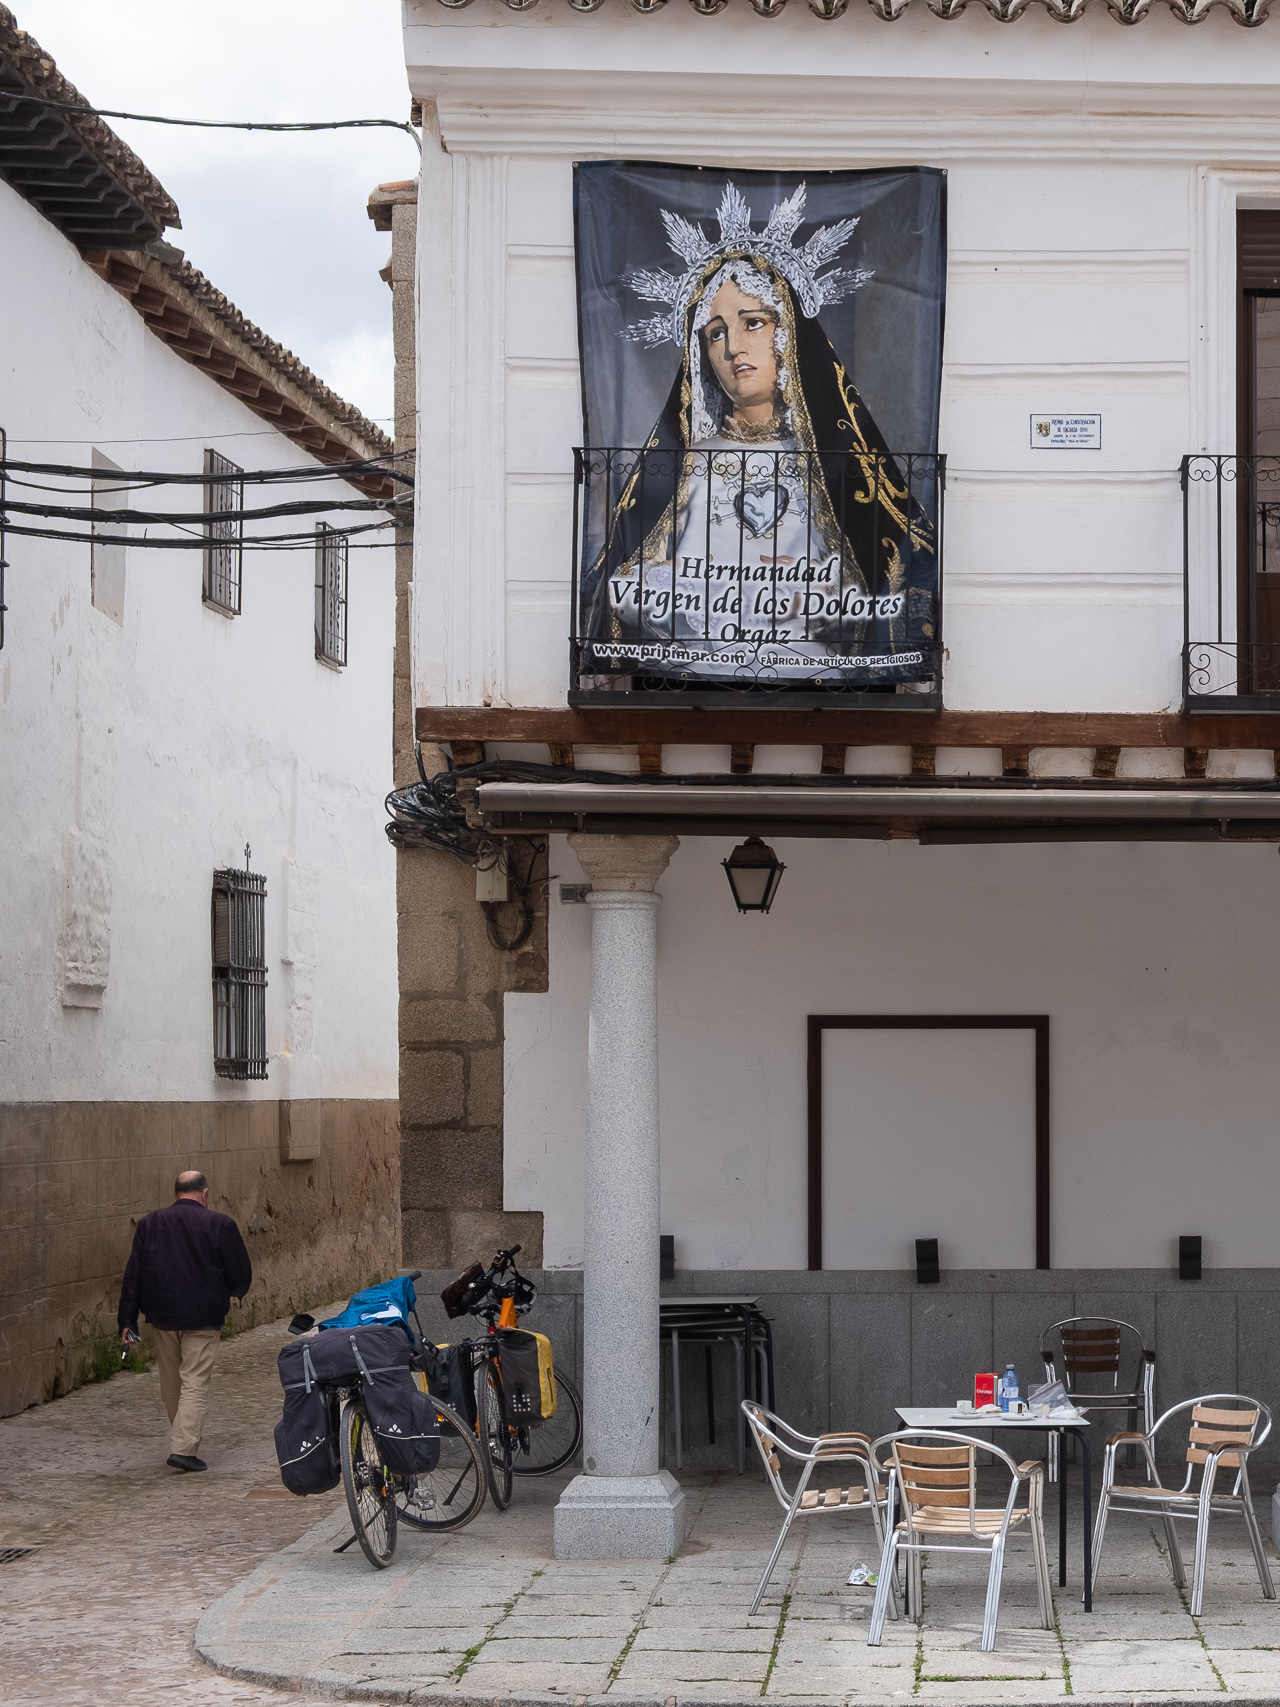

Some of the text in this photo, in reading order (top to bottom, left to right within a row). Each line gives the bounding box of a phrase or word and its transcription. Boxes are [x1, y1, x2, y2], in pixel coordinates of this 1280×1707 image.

[679, 556, 838, 582] Hermandad
[610, 580, 901, 619] Virgen de los Dolores
[721, 623, 792, 654] Orgaz
[594, 644, 746, 664] www.pripimar.com
[803, 658, 815, 667] DE
